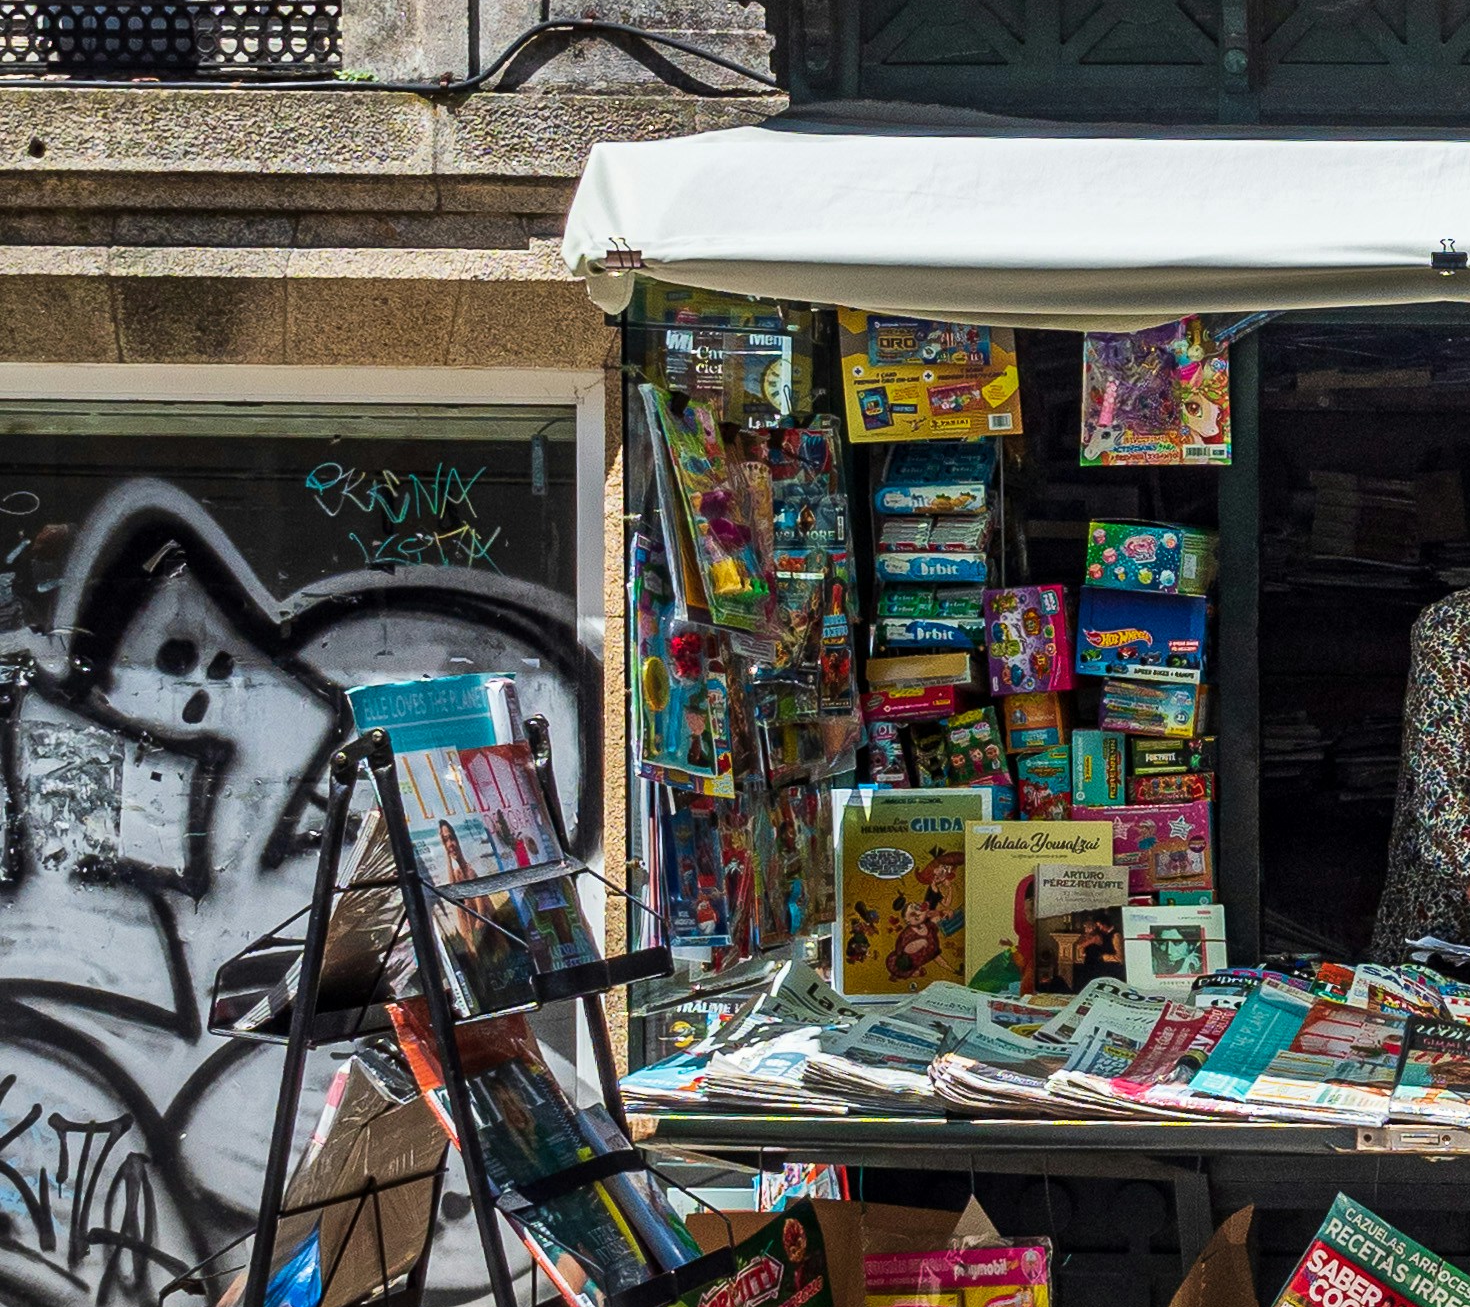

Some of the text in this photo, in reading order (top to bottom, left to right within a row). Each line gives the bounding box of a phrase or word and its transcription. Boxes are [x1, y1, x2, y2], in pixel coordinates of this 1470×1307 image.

[391, 693, 426, 718] LOVES
[910, 817, 964, 833] GILDA
[976, 832, 1100, 855] Malala Yousafzai
[1043, 878, 1124, 891] PÉREZ-REVERTE
[1063, 871, 1105, 880] ARTURO
[1346, 1207, 1407, 1259] CAZUELAS,
[1324, 1217, 1410, 1284] RECETAS
[1306, 1248, 1383, 1307] SABER
